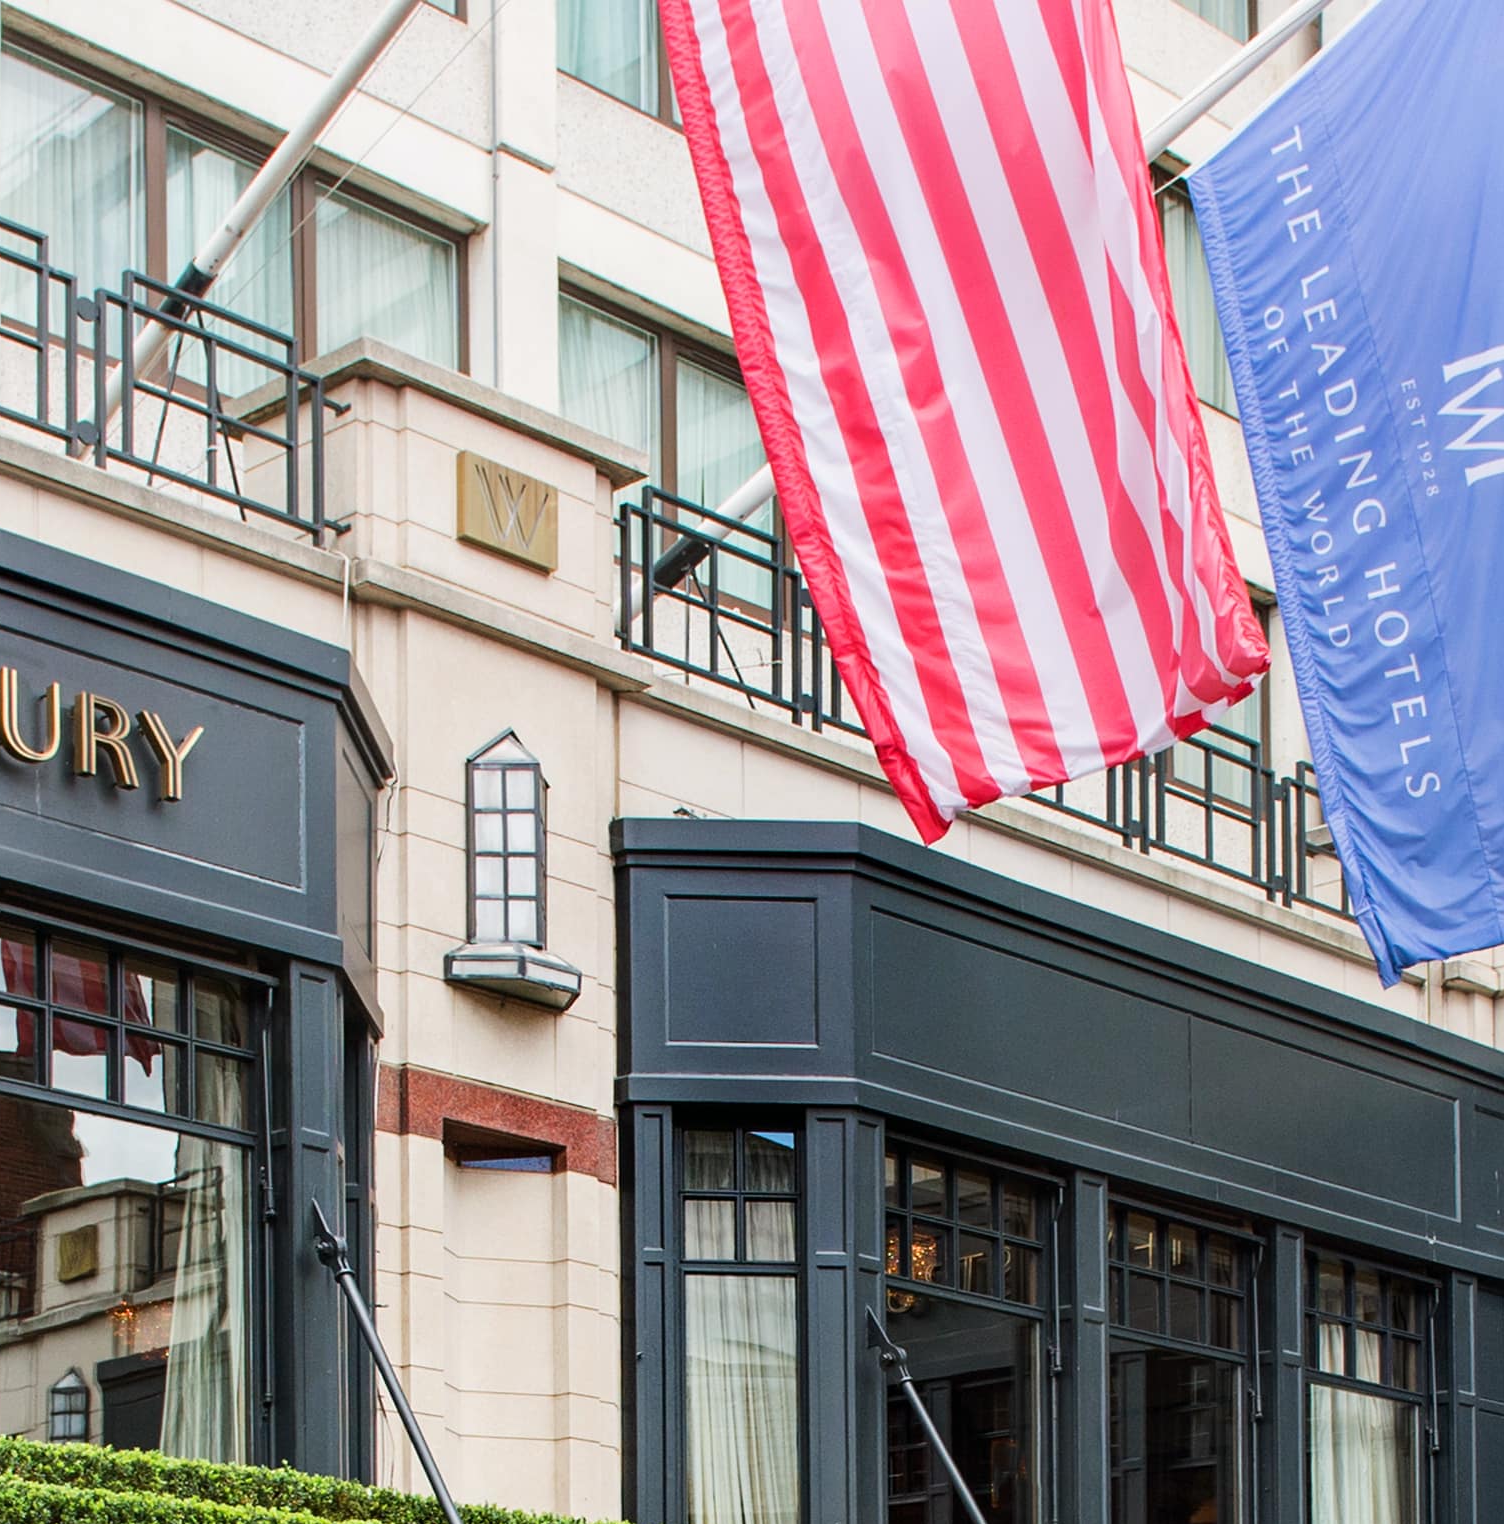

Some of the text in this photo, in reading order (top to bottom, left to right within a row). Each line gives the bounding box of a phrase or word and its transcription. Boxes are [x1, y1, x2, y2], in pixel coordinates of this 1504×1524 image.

[474, 463, 550, 551] W
[1262, 304, 1352, 649] OF THE WORLD
[1270, 125, 1441, 800] THE LEADING HOTELS
[1400, 378, 1440, 497] EST 1928
